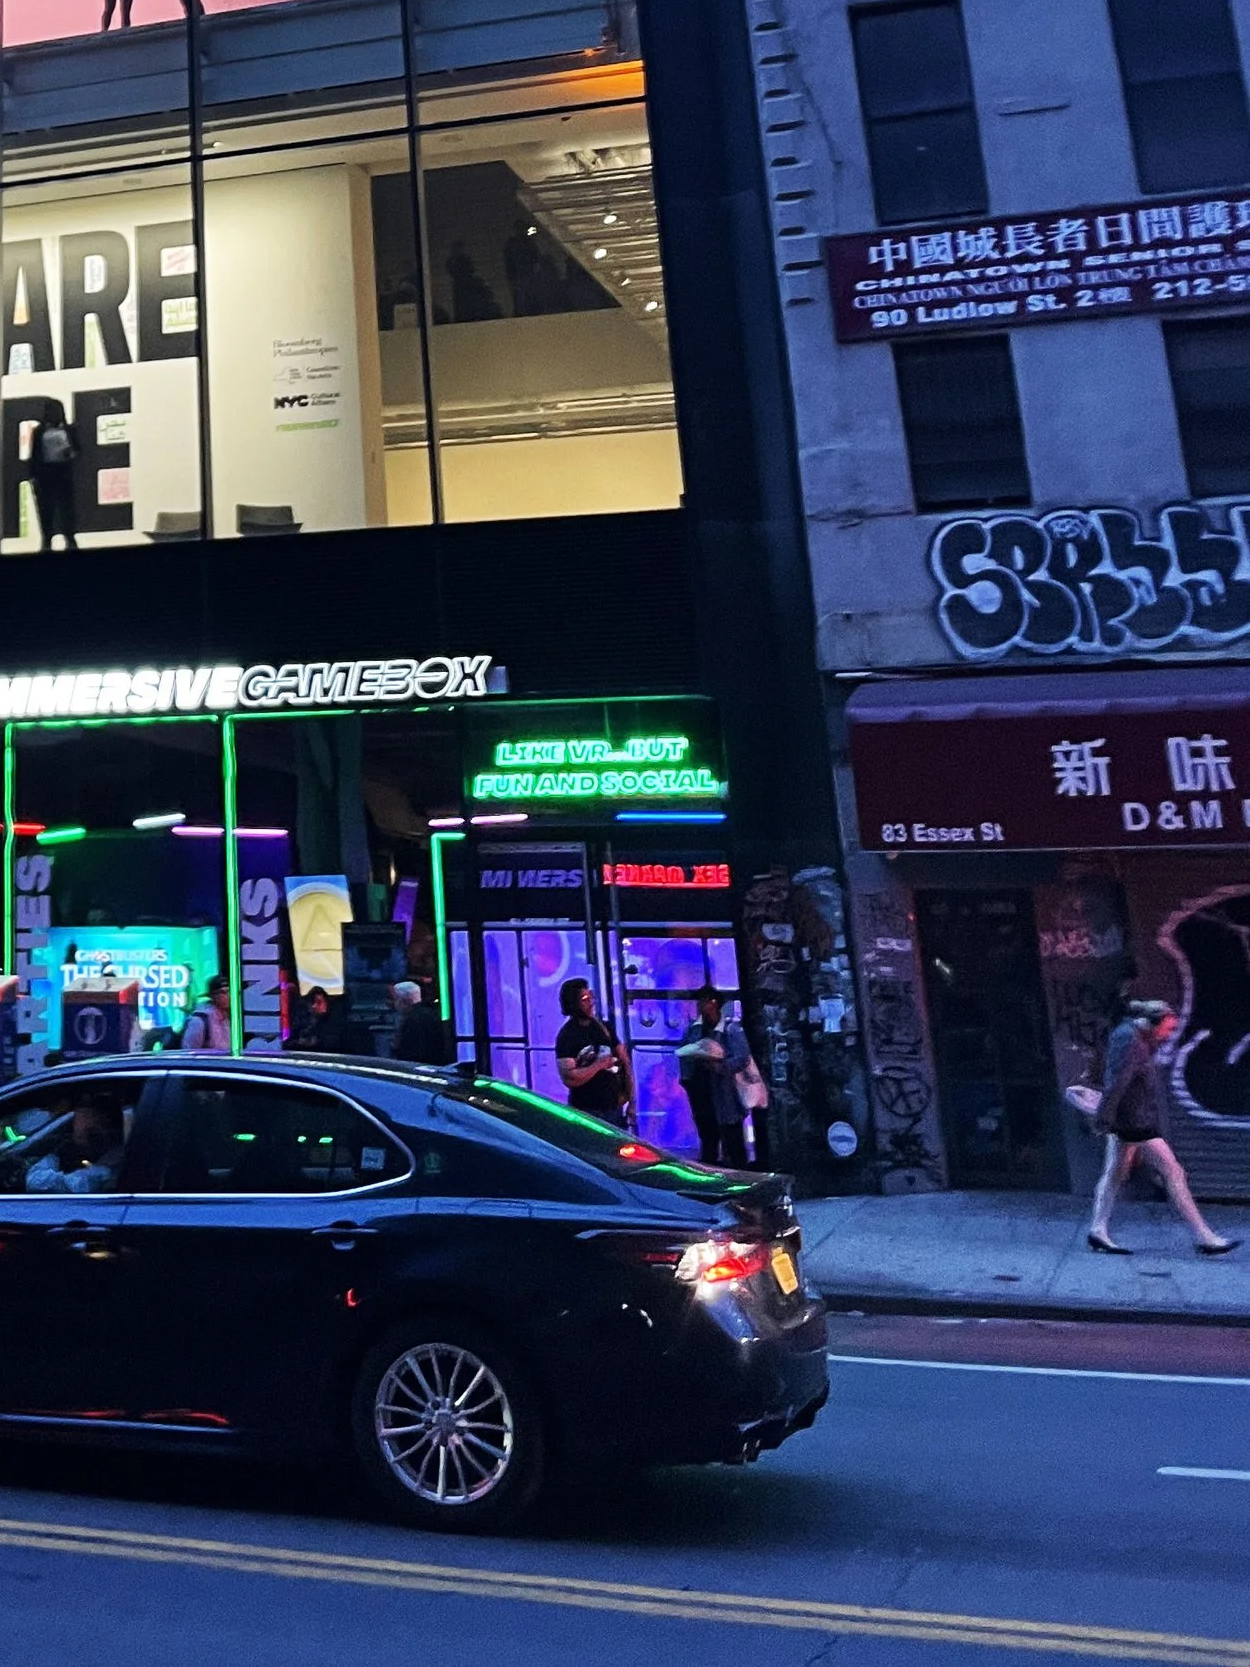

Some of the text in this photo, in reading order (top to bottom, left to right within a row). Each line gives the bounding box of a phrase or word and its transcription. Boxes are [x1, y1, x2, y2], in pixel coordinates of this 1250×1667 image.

[855, 259, 1071, 292] CHINATOWN
[1083, 243, 1224, 267] SENIOR
[854, 285, 963, 308] CHINATOWN
[870, 309, 908, 328] 90
[917, 300, 1018, 324] Ludlow
[1024, 293, 1067, 312] St.
[274, 395, 309, 409] NYC
[239, 655, 492, 709] GAMEBOX
[496, 742, 567, 766] LIKE
[473, 768, 720, 798] FUN AND SOCIAL
[1121, 800, 1224, 832] D&M
[881, 822, 1005, 843] 83 Essex St
[15, 854, 53, 1076] ARTIES
